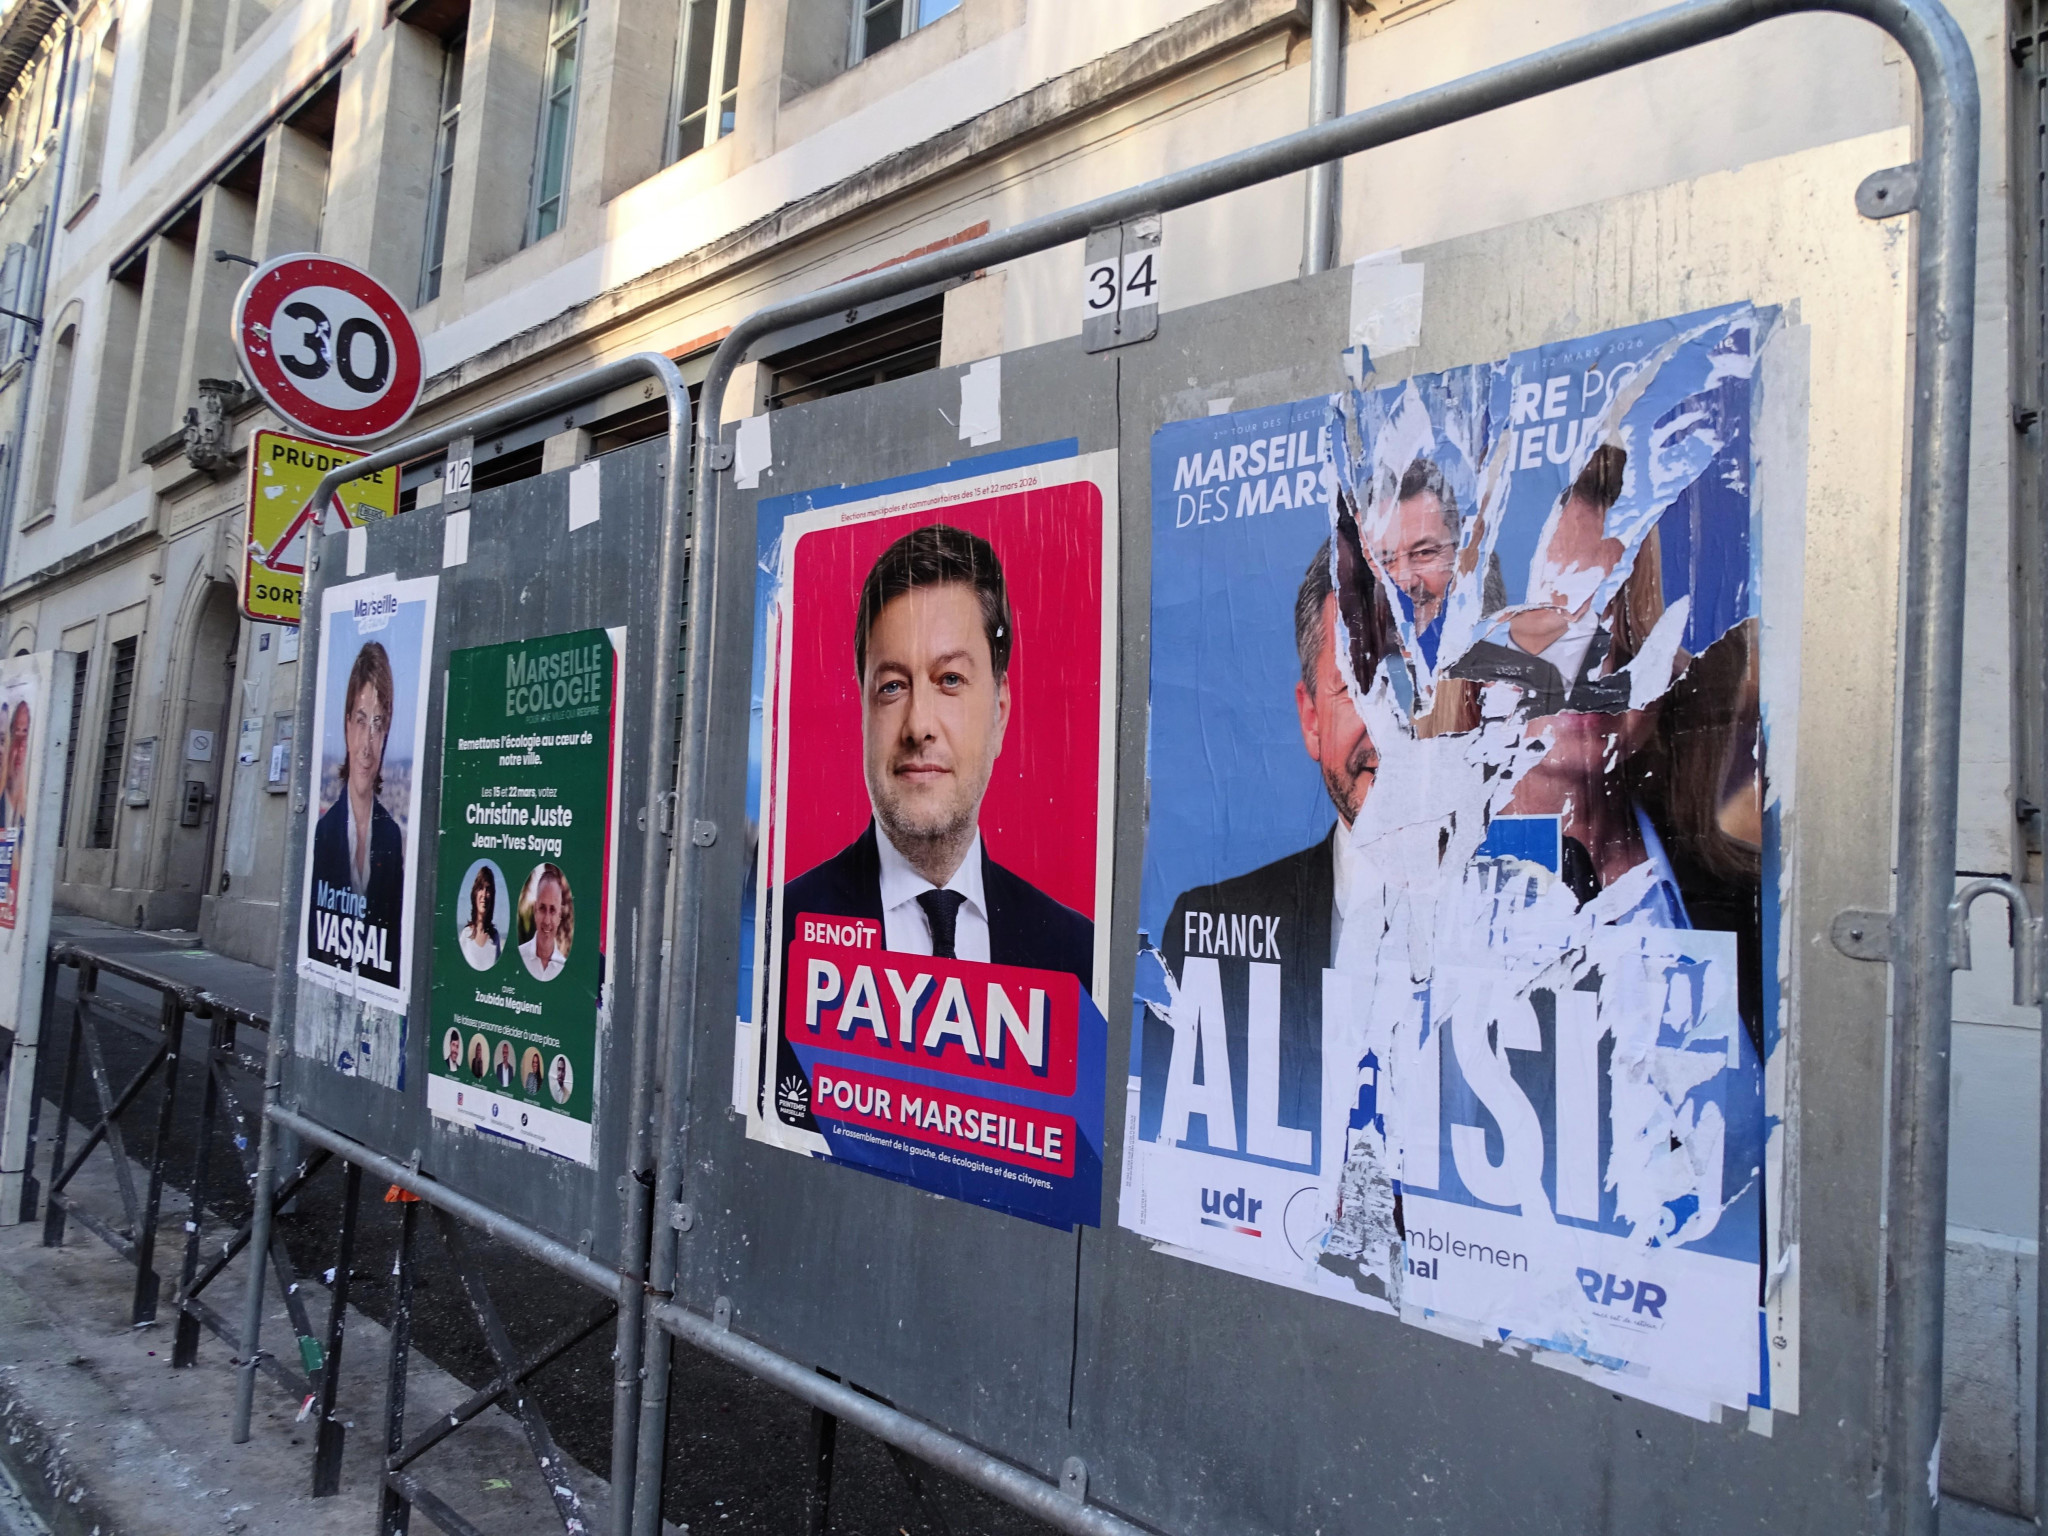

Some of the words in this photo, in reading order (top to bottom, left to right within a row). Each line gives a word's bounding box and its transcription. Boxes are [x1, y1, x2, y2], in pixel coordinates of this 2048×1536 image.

[280, 302, 389, 393] 30
[1564, 347, 1600, 363] MARS
[1609, 339, 1643, 354] 2026
[1231, 424, 1257, 435] TOUR
[1262, 418, 1281, 429] DES
[841, 511, 866, 522] Élections
[867, 504, 900, 519] municipales
[901, 502, 908, 511] et
[908, 493, 960, 510] communautaires
[961, 490, 973, 499] des
[975, 487, 981, 496] 15
[982, 486, 989, 494] et
[990, 484, 999, 493] 22
[1000, 481, 1018, 492] mars
[1019, 477, 1037, 488] 2026
[1176, 486, 1230, 528] DES
[354, 594, 397, 617] Marseille
[506, 644, 602, 688] MARSEILLE
[577, 706, 600, 717] RESPIRE
[458, 737, 500, 750] Remettons
[500, 733, 540, 752] l'écologie
[541, 736, 554, 747] au
[555, 734, 579, 747] cœur
[580, 731, 593, 744] de
[499, 753, 522, 766] notre
[523, 751, 542, 766] ville.
[481, 787, 492, 798] Les
[493, 786, 500, 797] 15
[500, 787, 508, 797] et
[509, 786, 517, 797] 22
[517, 787, 537, 799] mars,
[538, 787, 558, 798] votez
[466, 802, 529, 826] Christine
[531, 804, 573, 827] Juste
[472, 832, 526, 850] Jean-Yves
[528, 834, 562, 858] Sayag
[317, 879, 367, 919] Martine
[316, 910, 392, 973] VASSAL
[803, 920, 877, 949] BENOÎT
[1184, 911, 1281, 960] FRANCK
[475, 990, 504, 1007] Zoubida
[505, 997, 542, 1015] Meguenni
[502, 985, 515, 994] avec
[805, 958, 1046, 1069] PAYAN
[453, 1013, 461, 1023] Ne
[462, 1015, 478, 1028] laissez
[478, 1020, 502, 1034] personne
[502, 1025, 523, 1039] décider
[523, 1029, 528, 1039] à
[528, 1031, 542, 1043] votre
[543, 1035, 560, 1048] place.
[779, 1099, 806, 1112] PRINTEMPS
[817, 1076, 892, 1120] POUR
[900, 1094, 1063, 1161] MARSEILLE
[832, 1124, 841, 1135] Le
[842, 1127, 893, 1148] rassemblement
[893, 1140, 902, 1150] de
[903, 1142, 909, 1152] la
[909, 1145, 937, 1160] gauche,
[938, 1152, 951, 1163] des
[952, 1154, 993, 1175] écologistes
[994, 1165, 1002, 1176] et
[1003, 1168, 1017, 1180] des
[1018, 1172, 1054, 1190] citoyens.
[1201, 1187, 1262, 1224] udr
